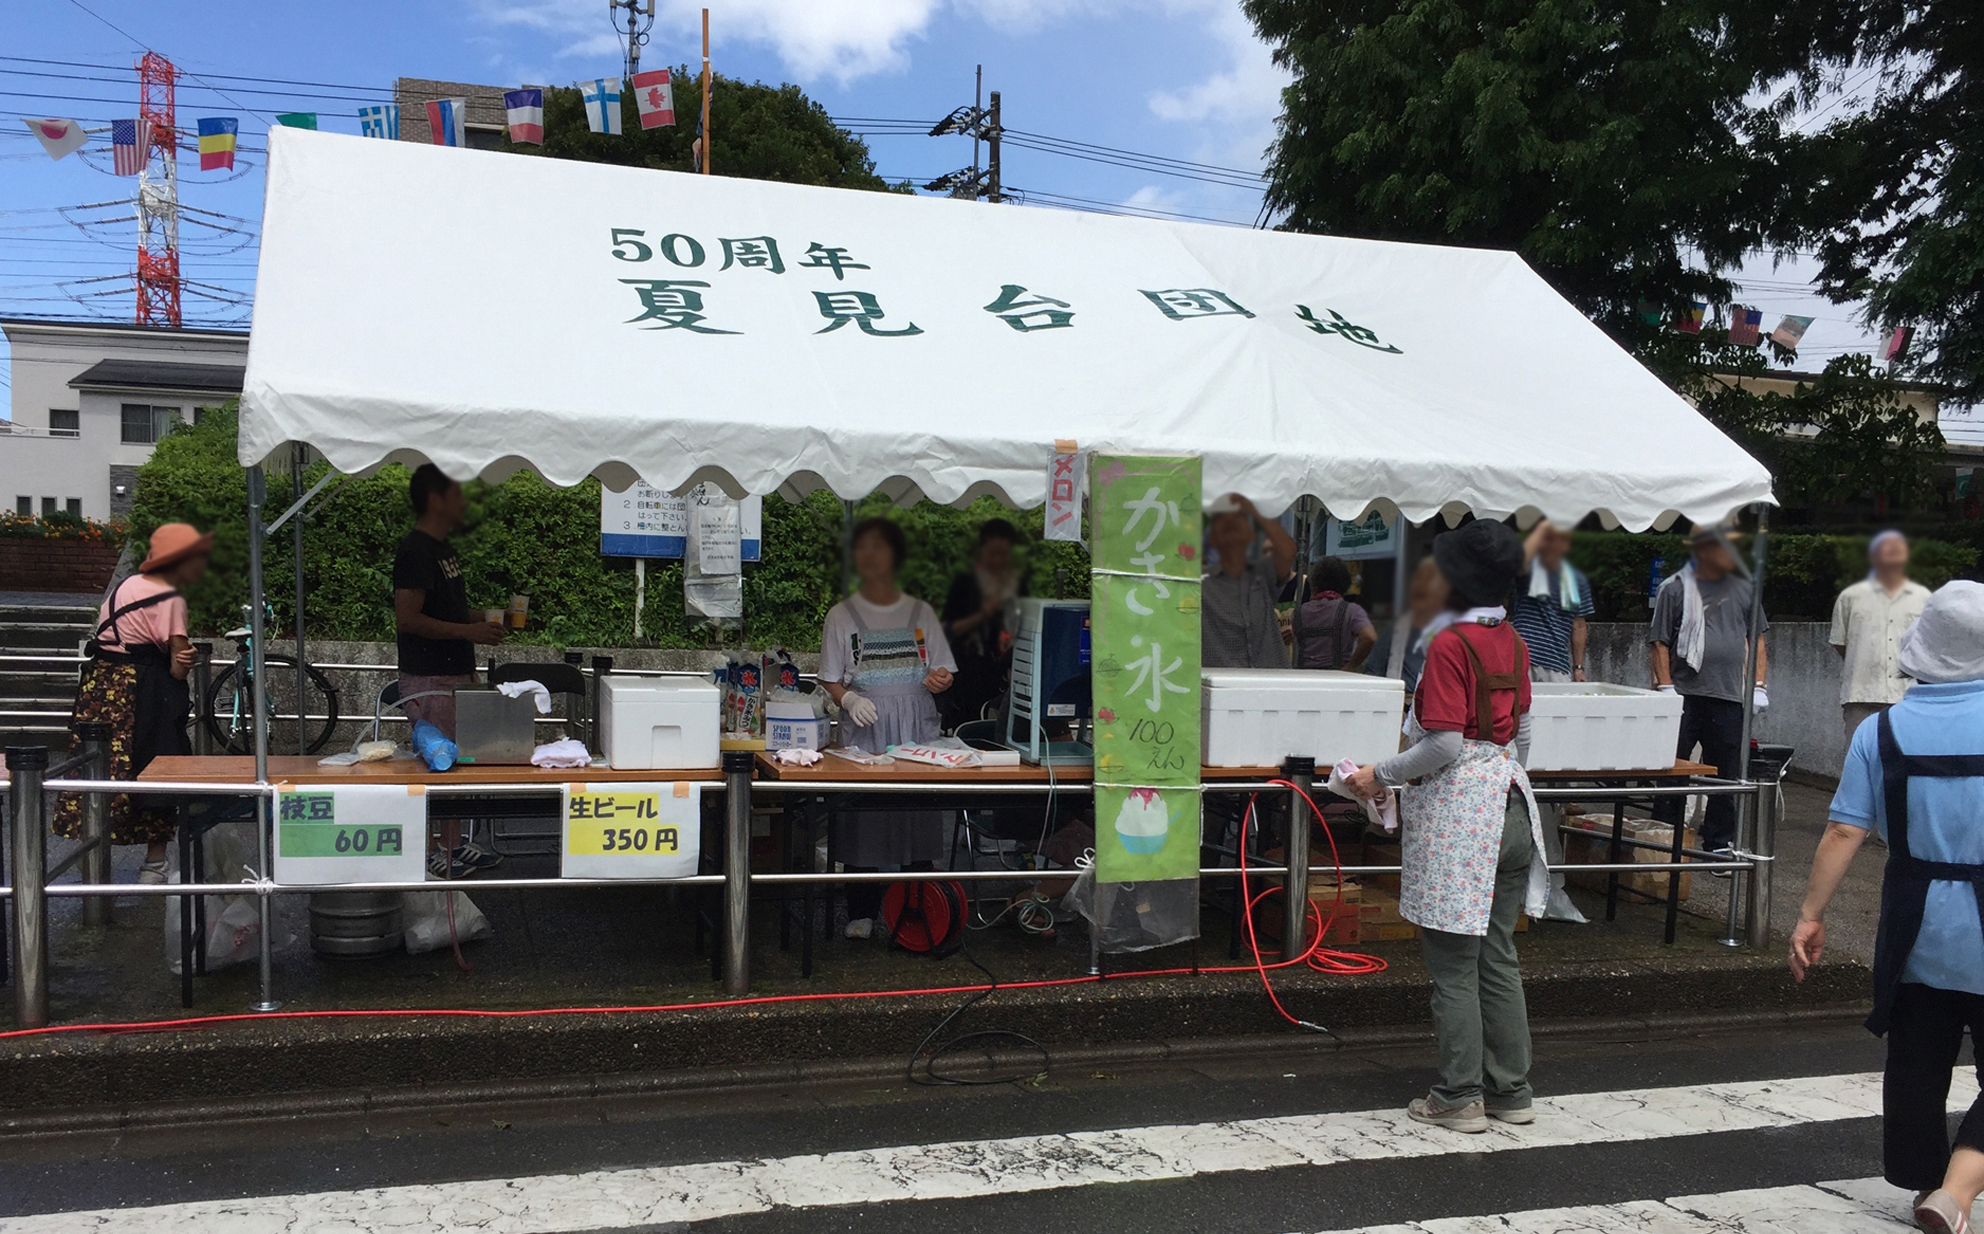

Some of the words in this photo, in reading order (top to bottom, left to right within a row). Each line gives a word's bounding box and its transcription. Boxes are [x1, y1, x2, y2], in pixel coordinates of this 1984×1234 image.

[611, 227, 872, 281] 50周年
[617, 277, 1404, 354] 夏見台団地
[1052, 454, 1074, 526] メロン
[1122, 486, 1190, 713] かき氷
[741, 670, 758, 687] 氷
[780, 670, 796, 687] 氷
[1129, 718, 1174, 745] 100
[1146, 745, 1184, 770] えん
[280, 795, 334, 821] 枝豆
[569, 796, 658, 819] 生ビール
